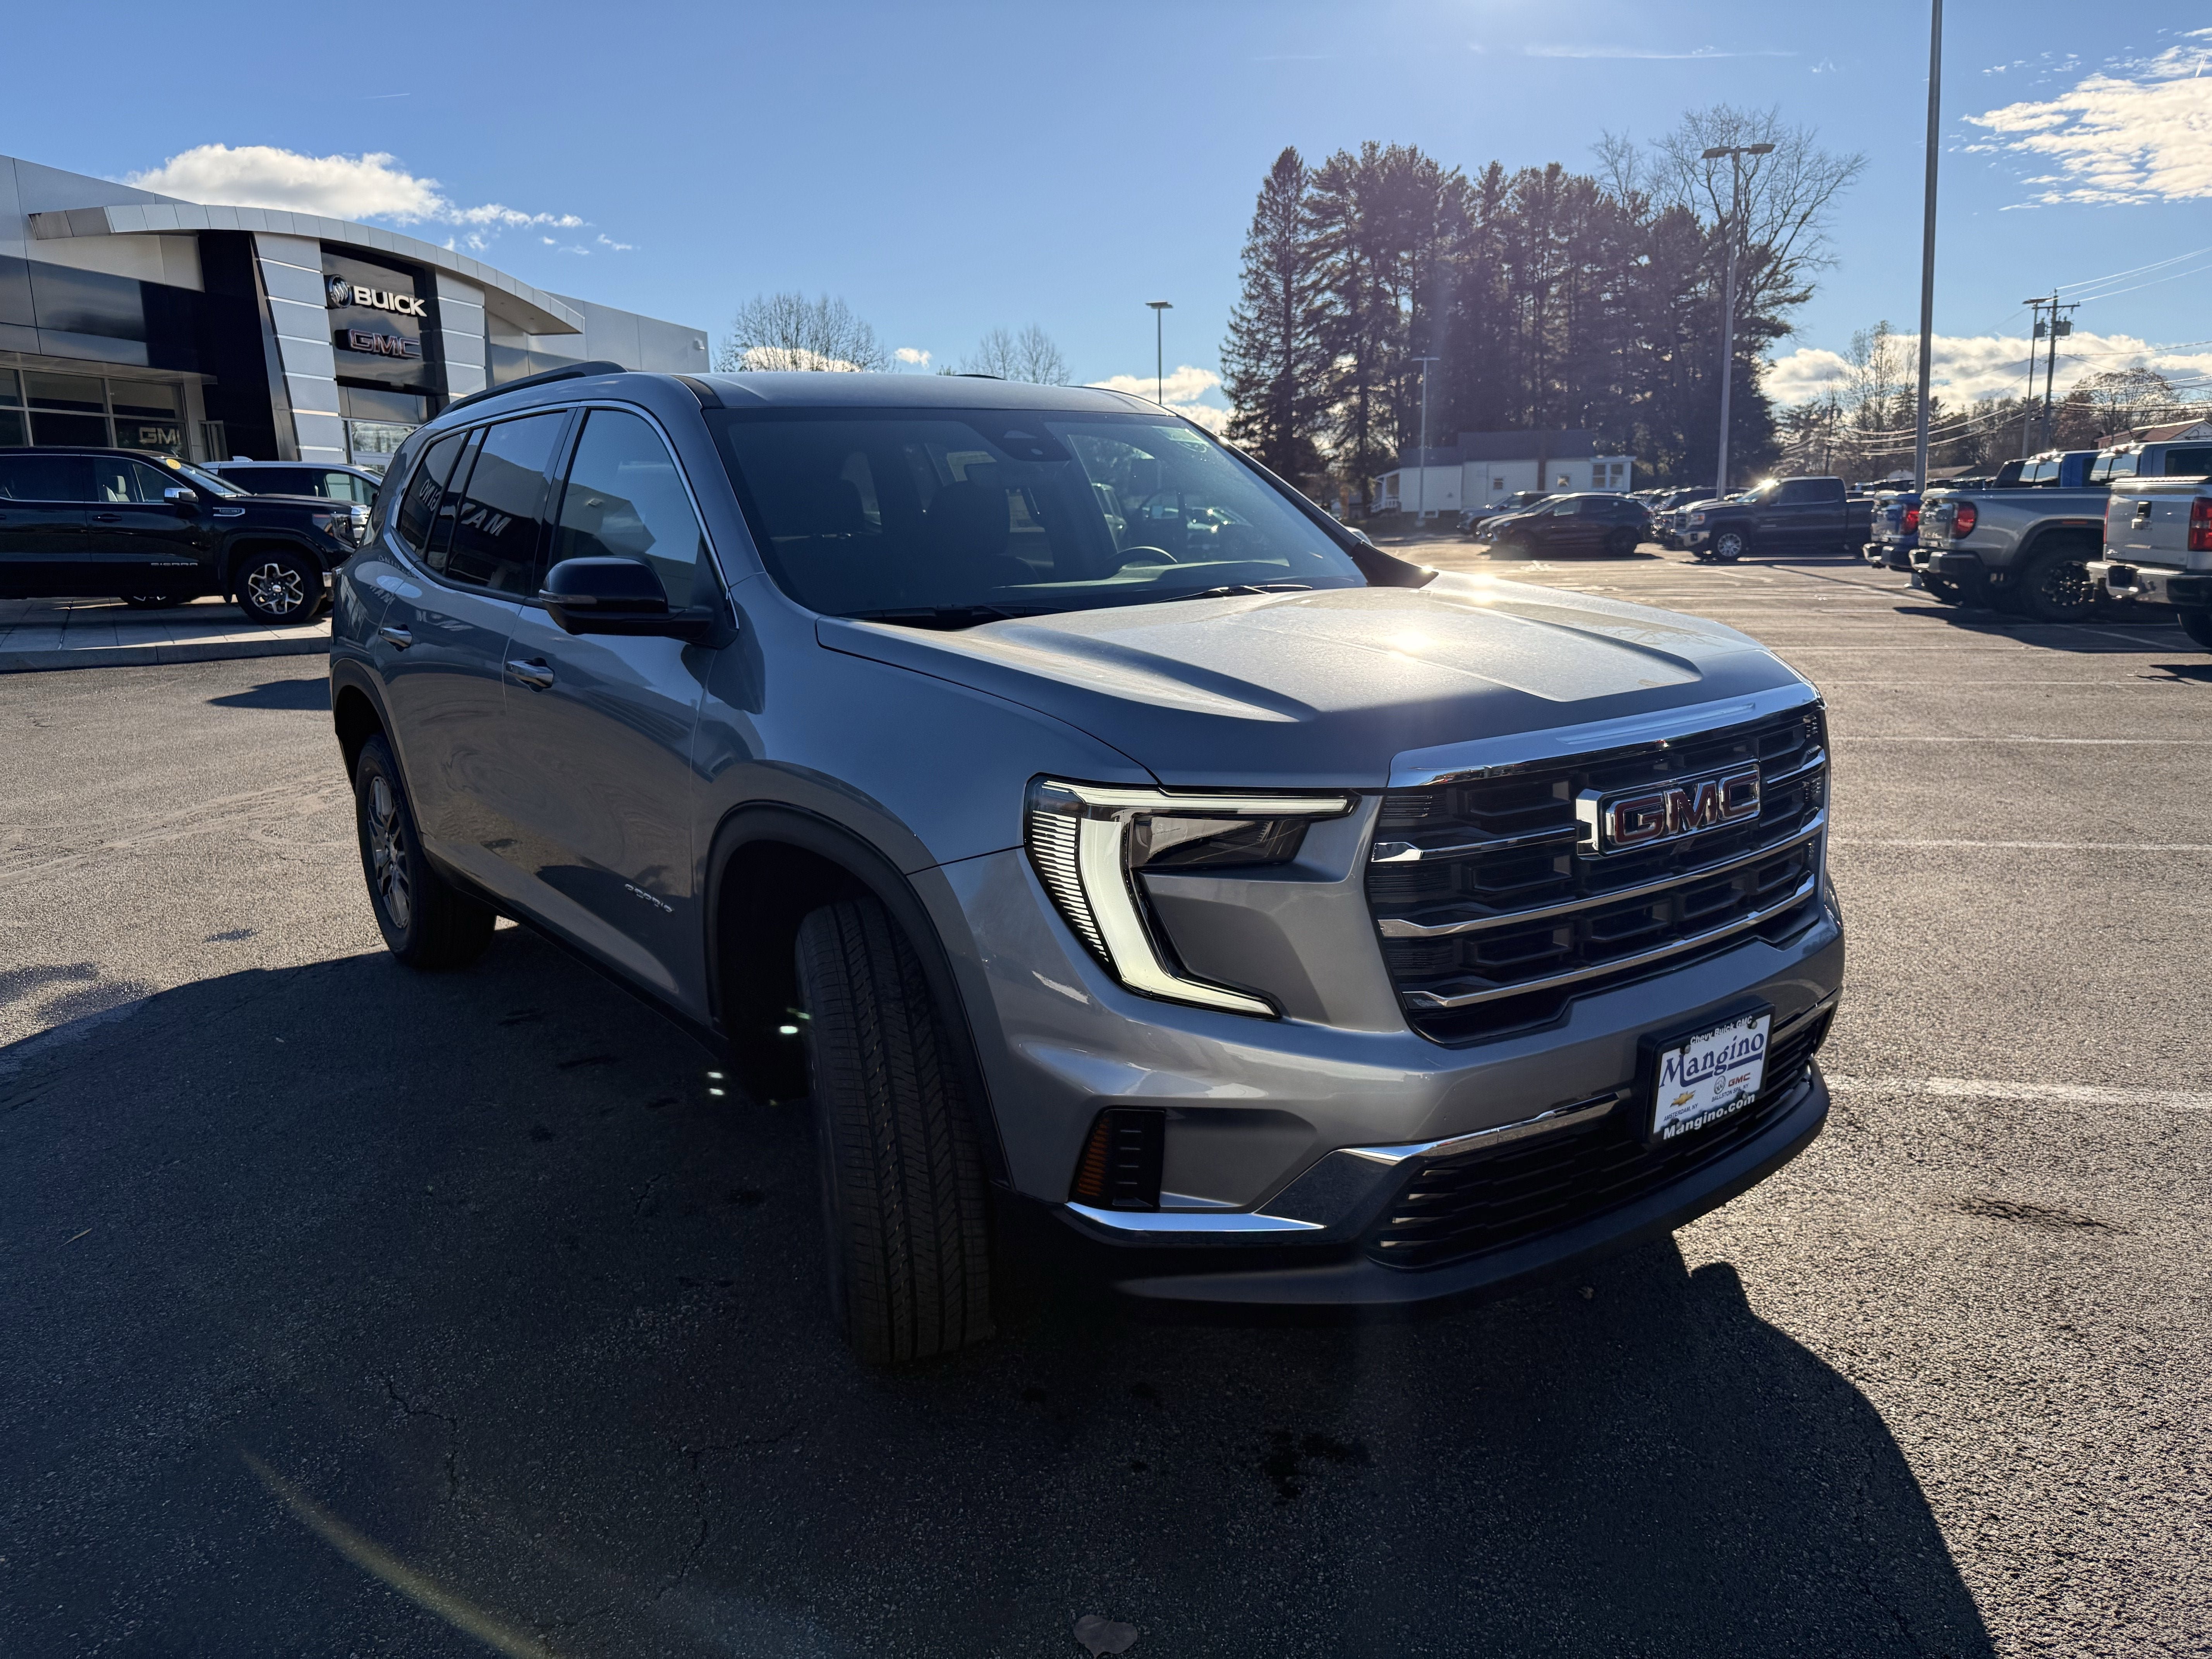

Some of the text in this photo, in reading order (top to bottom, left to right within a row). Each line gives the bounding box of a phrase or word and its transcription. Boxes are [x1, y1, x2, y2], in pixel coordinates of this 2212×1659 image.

[353, 286, 427, 317] BUICK
[349, 328, 421, 359] GMC
[139, 427, 181, 445] GM
[1606, 769, 1760, 845] GMC
[1690, 1015, 1753, 1045] Chevy Buick GMC
[1659, 1033, 1764, 1087] Mangino
[1728, 1072, 1751, 1087] GMC
[1711, 1089, 1733, 1102] BALLSTON
[1663, 1094, 1755, 1140] Mangino.com
[1664, 1107, 1691, 1121] AMSTERDAM,
